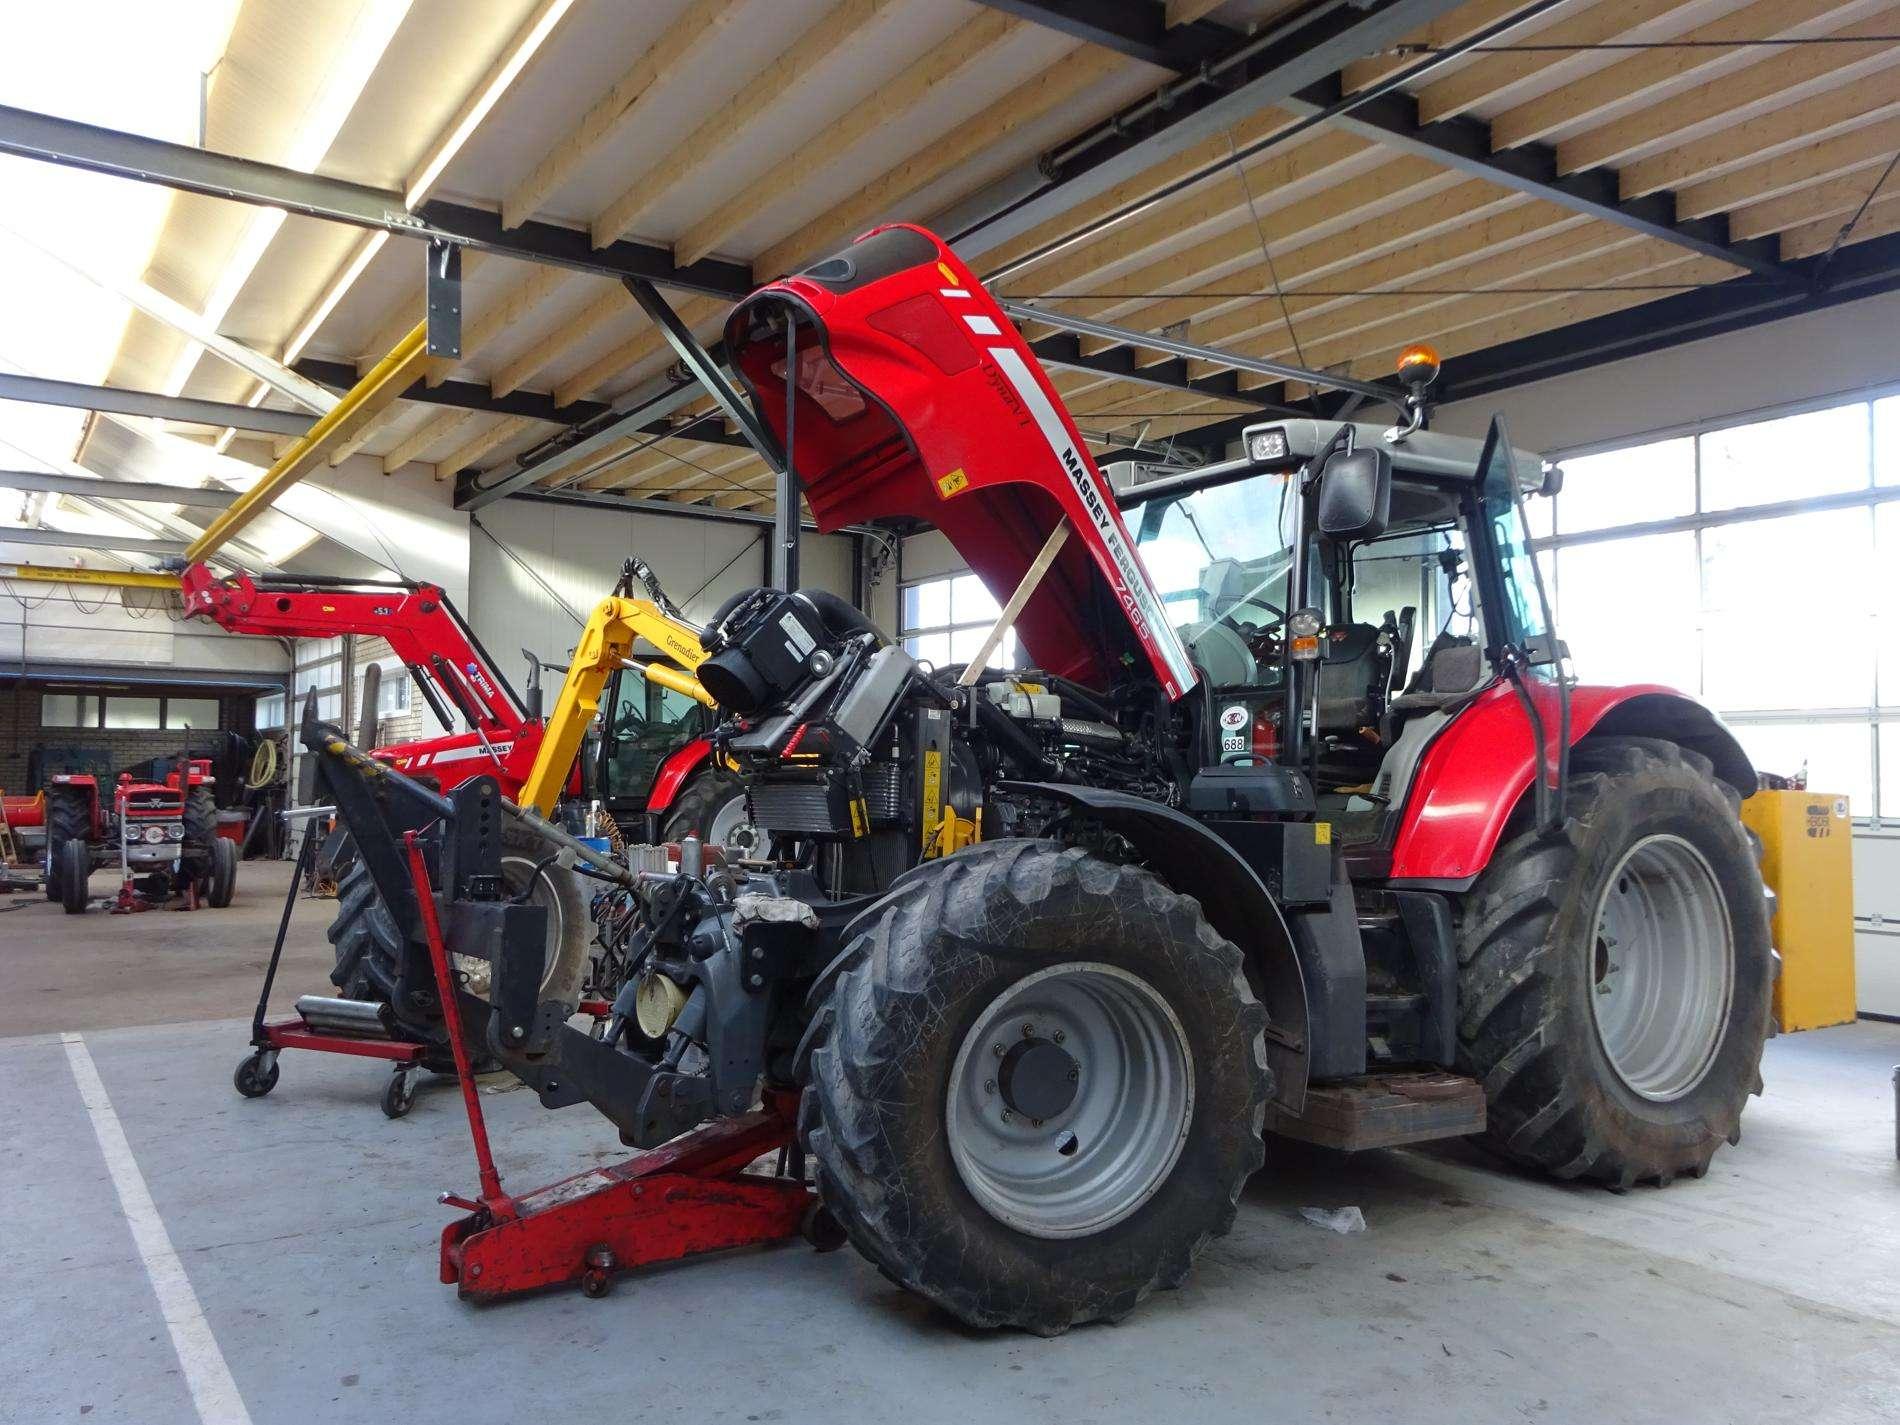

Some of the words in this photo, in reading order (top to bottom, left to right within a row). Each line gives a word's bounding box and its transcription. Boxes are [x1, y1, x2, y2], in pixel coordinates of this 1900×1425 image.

[1062, 447, 1110, 530] MASSEY
[1115, 578, 1151, 640] 7465
[666, 634, 700, 663] Grenadier
[479, 744, 512, 755] MSSEY
[1224, 738, 1243, 750] 688
